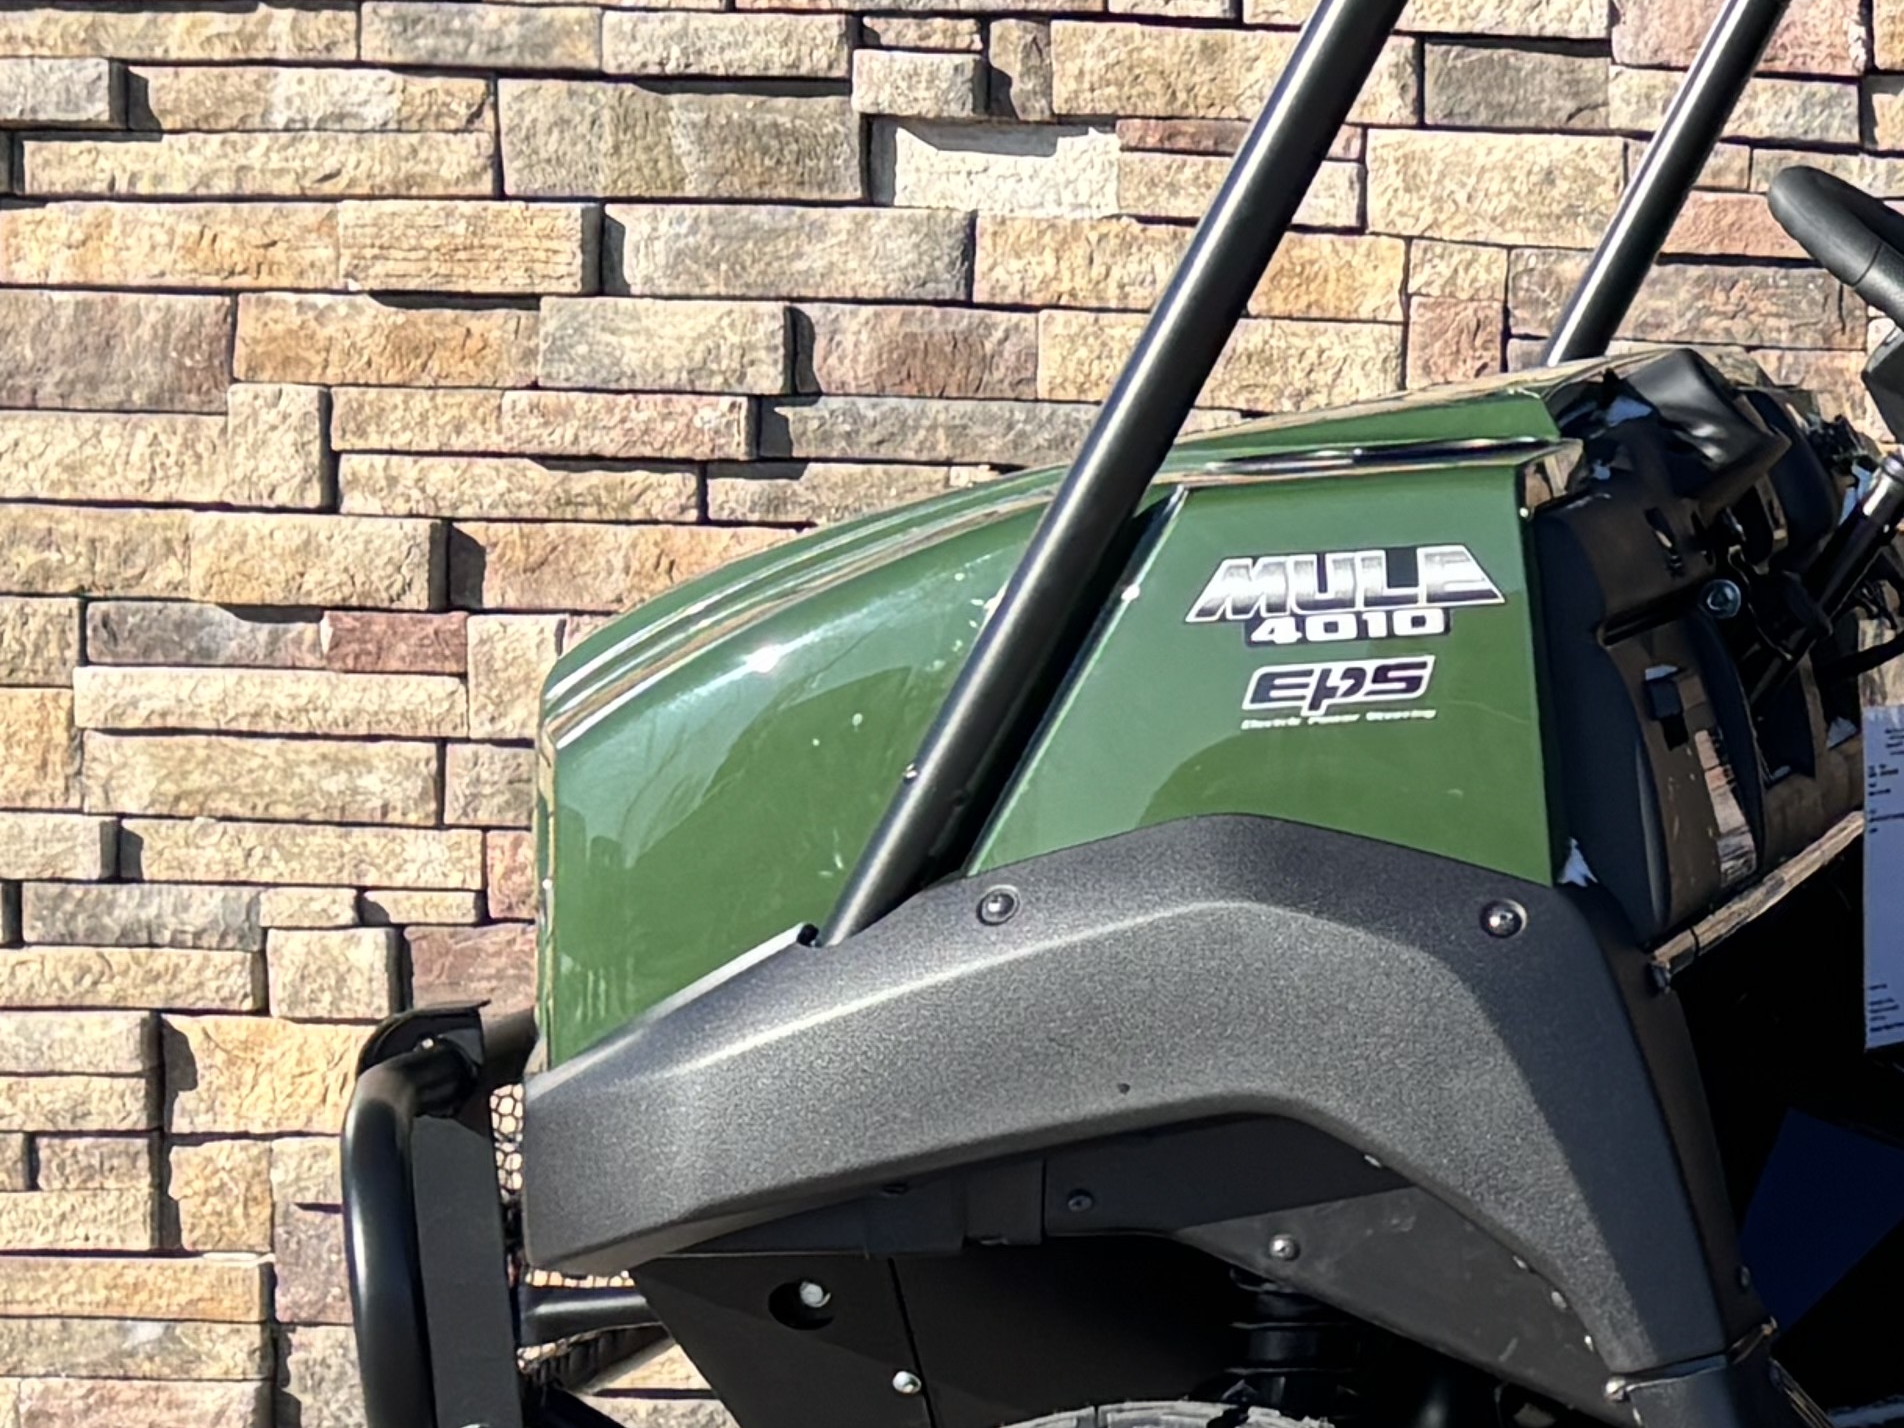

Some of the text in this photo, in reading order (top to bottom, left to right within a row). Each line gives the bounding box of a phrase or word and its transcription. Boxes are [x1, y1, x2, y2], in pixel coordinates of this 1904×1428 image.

[1185, 543, 1505, 623] MULE
[1250, 608, 1446, 645] 4010
[1241, 654, 1436, 717] EPS
